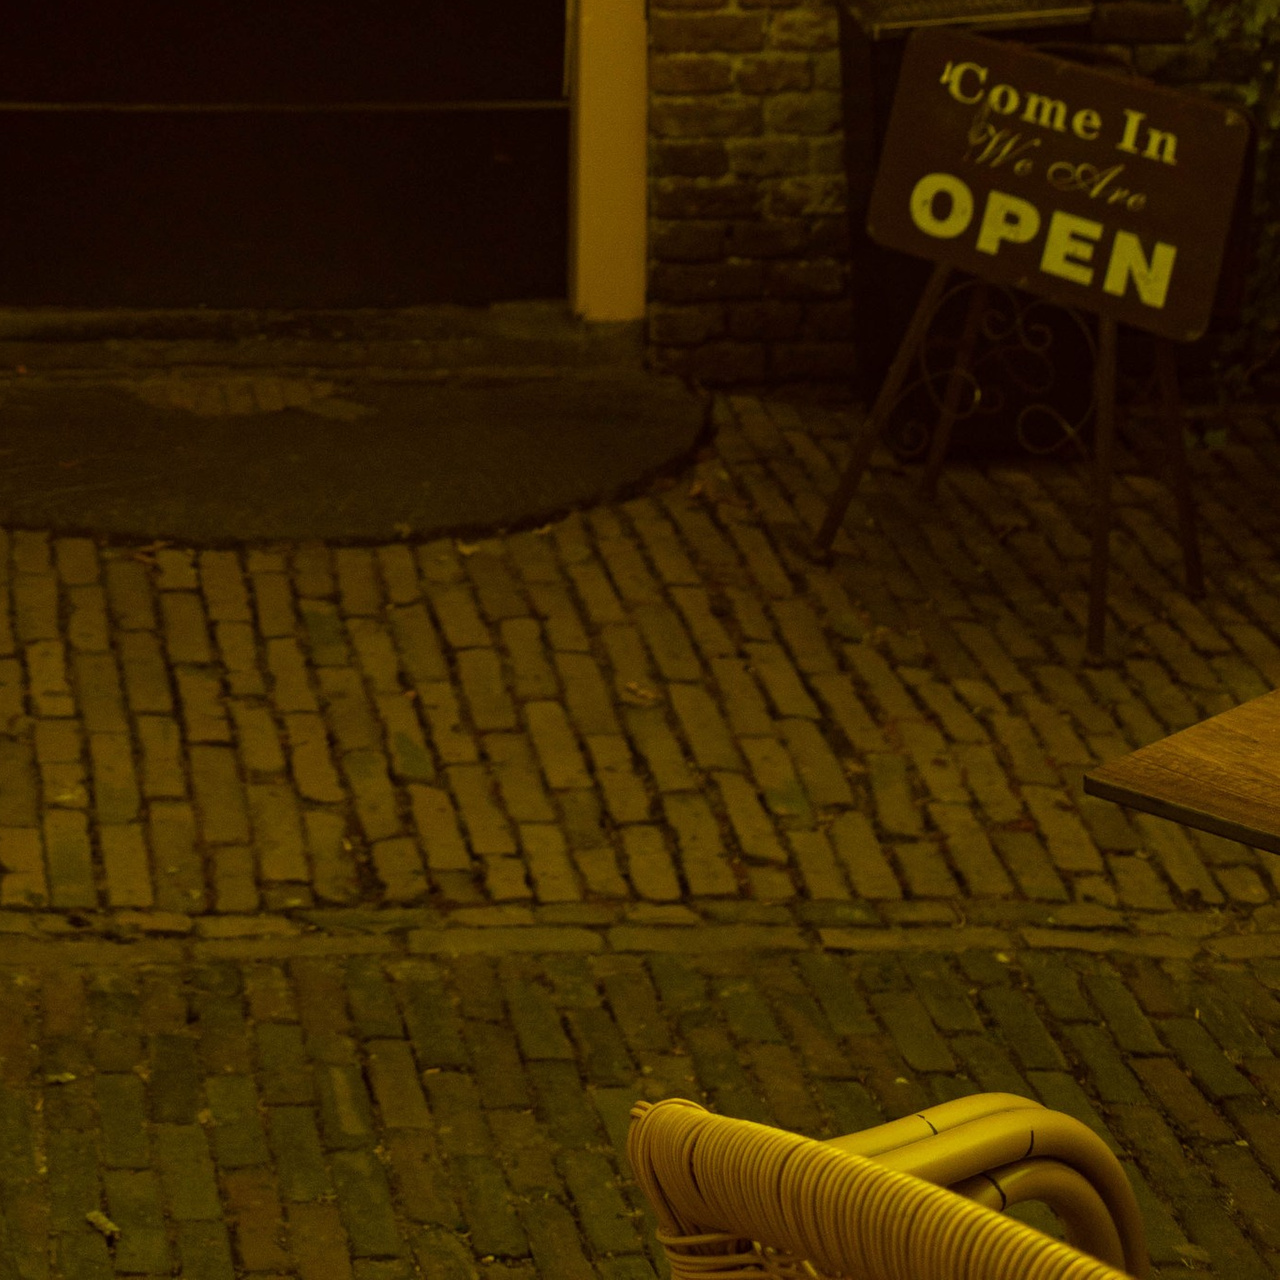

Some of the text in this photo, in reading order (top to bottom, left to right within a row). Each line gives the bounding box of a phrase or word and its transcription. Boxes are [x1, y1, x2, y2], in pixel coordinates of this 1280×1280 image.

[940, 60, 1179, 166] Come In
[963, 106, 1148, 212] We Are
[908, 171, 1179, 310] OPEN
